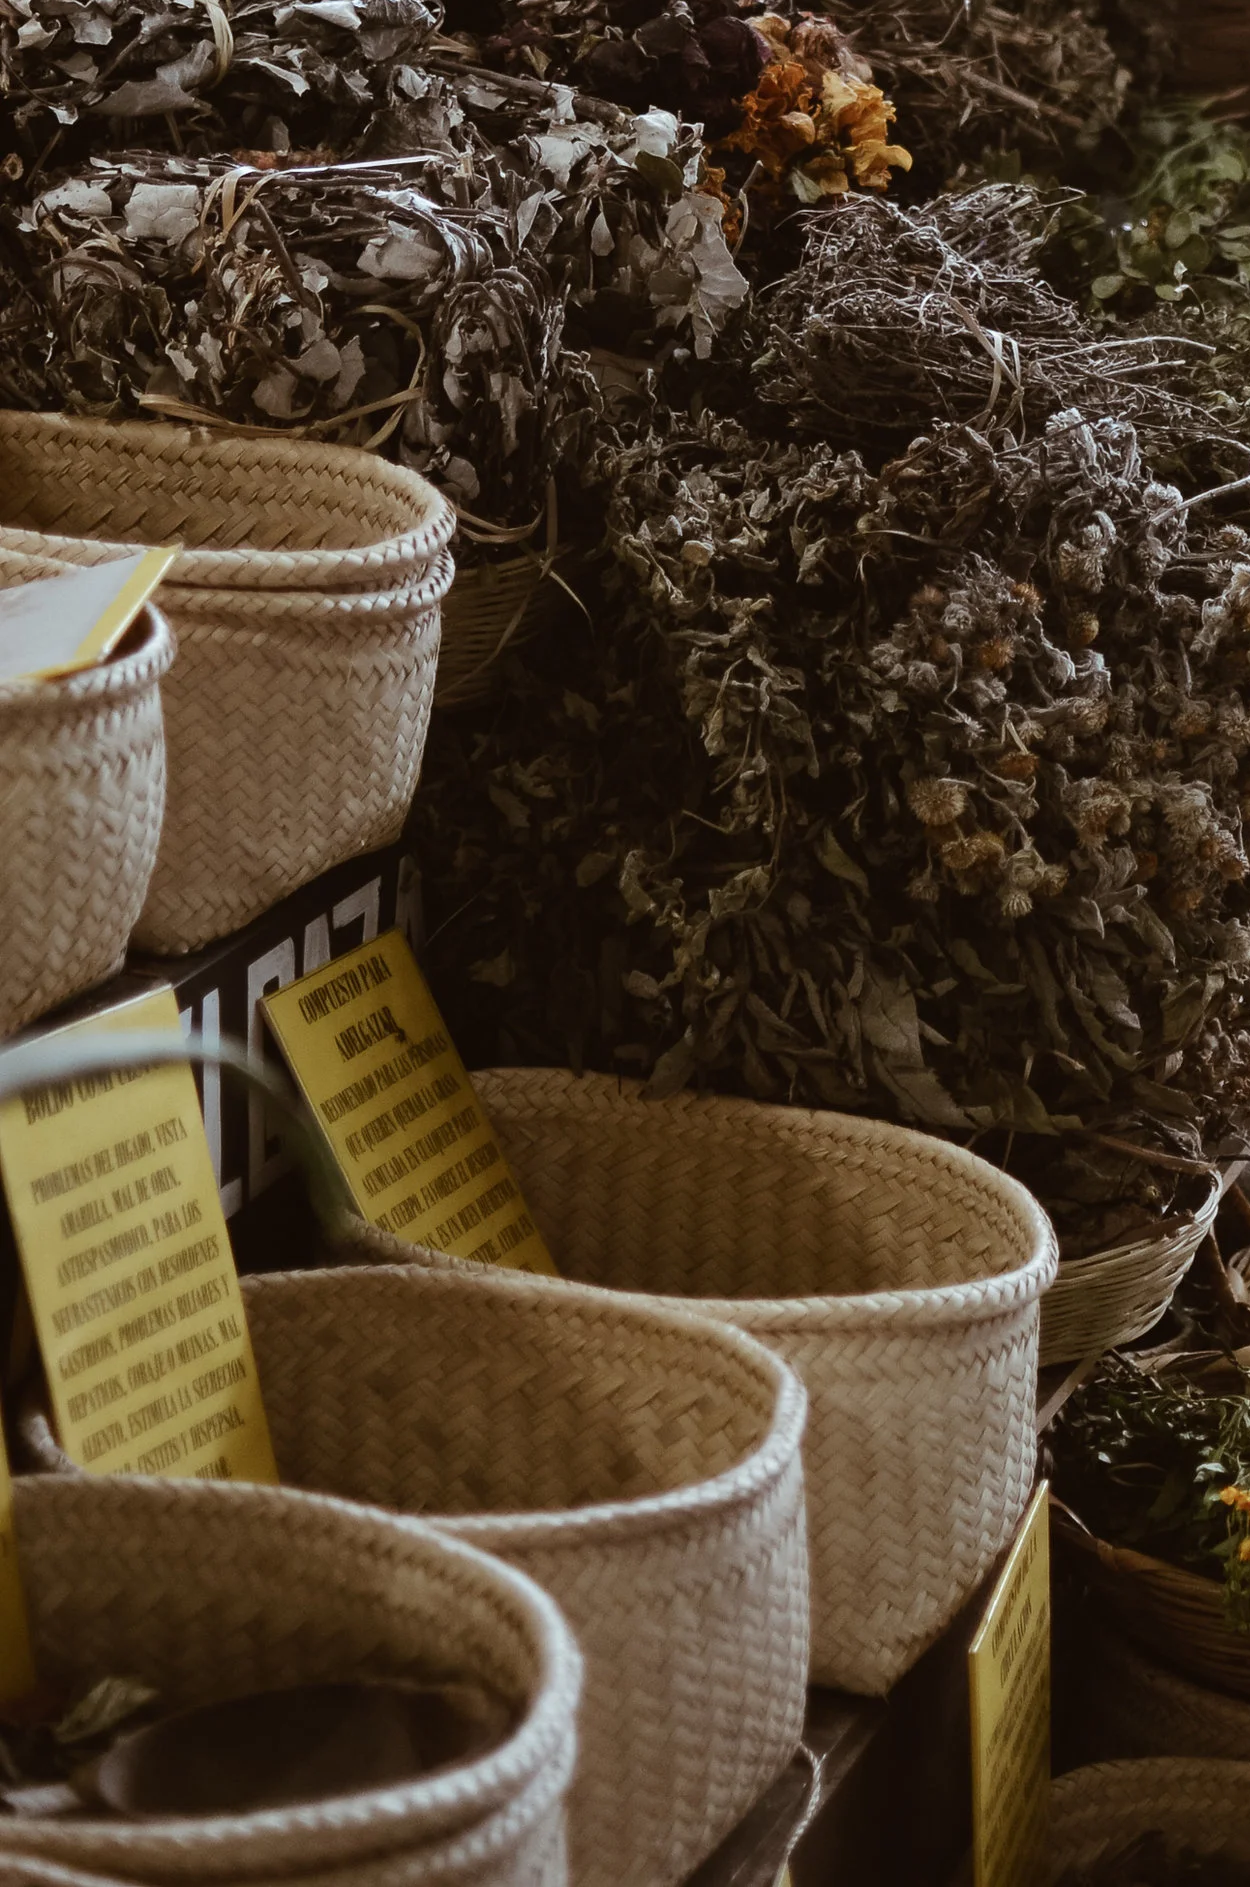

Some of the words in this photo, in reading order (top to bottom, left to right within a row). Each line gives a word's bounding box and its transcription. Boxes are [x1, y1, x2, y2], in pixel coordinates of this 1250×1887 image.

[298, 969, 366, 1024] COMPUESTO
[357, 953, 392, 990] PARA
[320, 1074, 378, 1123] RECOMENDADO
[373, 1063, 399, 1091] PARA
[392, 1052, 413, 1079] LAS
[344, 1131, 367, 1163] QUE
[360, 1111, 398, 1152] QUIEREN
[391, 1092, 427, 1131] QUEMAR
[419, 1086, 437, 1109] LA
[430, 1073, 461, 1102] GRASA
[30, 1157, 93, 1204] PROBLEMAS
[92, 1148, 115, 1178] DEL
[153, 1117, 188, 1147] VISTA
[362, 1155, 410, 1197] ACUMULADA
[402, 1145, 421, 1170] EN
[450, 1105, 480, 1137] PARTE
[454, 1160, 470, 1184] EL
[111, 1184, 136, 1213] MAL
[134, 1177, 151, 1204] DE
[151, 1211, 182, 1242] PARA
[181, 1199, 202, 1228] LOS
[136, 1266, 158, 1293] CON
[157, 1234, 220, 1284] DESORDENES
[117, 1302, 177, 1350] PROBLEMAS
[219, 1272, 230, 1297] Y
[126, 1352, 167, 1391] CORAJE
[166, 1347, 176, 1370] O
[217, 1314, 242, 1342] MAL
[127, 1395, 178, 1437] ESTIMULA
[177, 1385, 193, 1412] LA
[179, 1431, 189, 1456] Y
